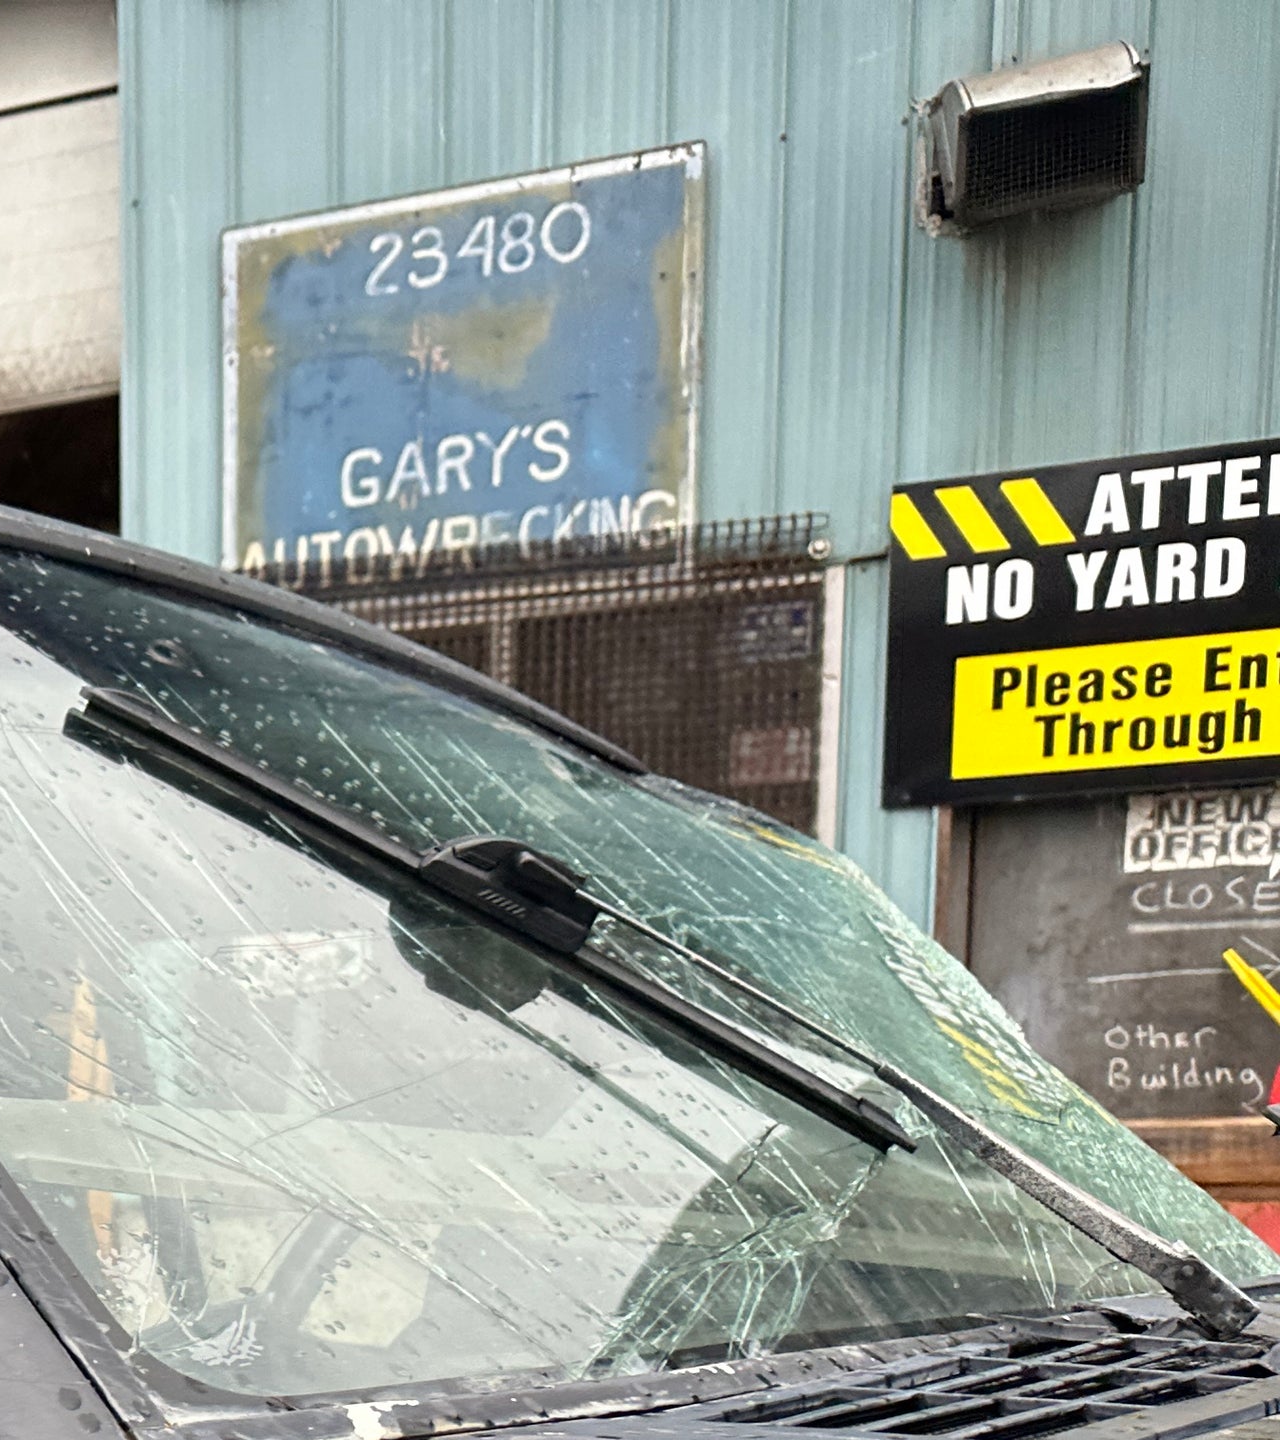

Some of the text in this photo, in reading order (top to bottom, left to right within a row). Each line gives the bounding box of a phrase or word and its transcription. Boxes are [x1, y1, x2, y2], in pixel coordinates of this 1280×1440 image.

[366, 202, 590, 296] 23480
[341, 420, 571, 507] GARY'S
[946, 537, 1247, 625] NO YARD
[991, 645, 1280, 711] Please En
[1034, 698, 1262, 758] Through
[1153, 792, 1270, 827] NEW
[1131, 876, 1280, 913] CLOSE
[1105, 1024, 1217, 1050] Other
[1108, 1057, 1264, 1111] Building
